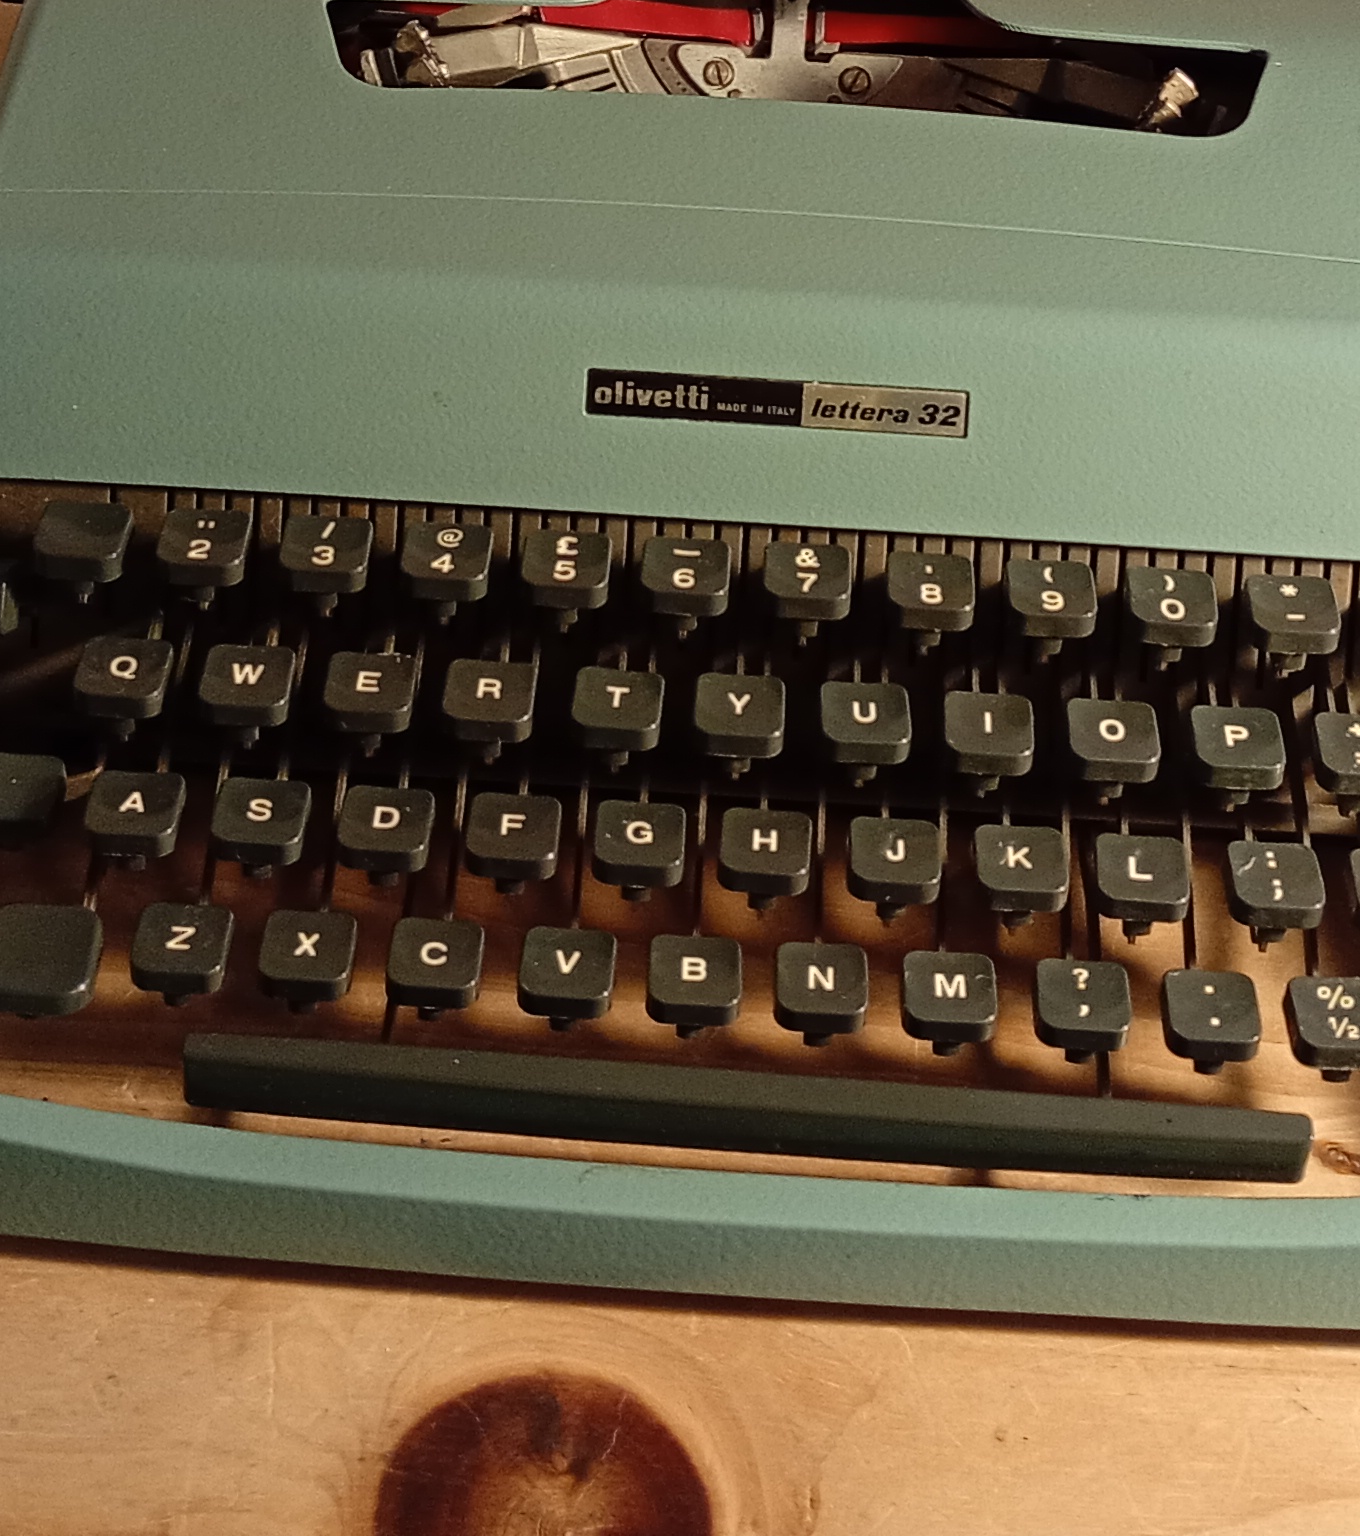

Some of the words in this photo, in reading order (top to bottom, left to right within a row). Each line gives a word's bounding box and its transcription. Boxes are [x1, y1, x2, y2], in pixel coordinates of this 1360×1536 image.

[594, 381, 709, 410] olivetti
[716, 402, 747, 413] MADE
[752, 404, 764, 414] IN
[767, 405, 796, 416] ITALY
[810, 398, 909, 424] lettera
[918, 404, 961, 428] 32
[187, 539, 211, 559] 2
[311, 545, 335, 566] 3
[430, 553, 455, 573] 4
[553, 560, 576, 581] 5
[672, 568, 695, 588] 6
[796, 572, 818, 593] 7
[920, 583, 943, 604] 8
[1041, 590, 1065, 611] 9
[436, 528, 464, 548] @
[556, 536, 579, 556] £
[795, 548, 821, 568] &
[109, 655, 138, 680] Q
[232, 663, 265, 685] W
[355, 670, 382, 692] E
[476, 677, 502, 699] R
[606, 685, 630, 708] T
[727, 692, 751, 715] Y
[852, 701, 877, 723] U
[984, 711, 992, 733] I
[1098, 718, 1125, 742] O
[1223, 724, 1249, 747] P
[119, 791, 145, 813] A
[246, 798, 273, 822] S
[372, 806, 401, 830] D
[500, 814, 526, 836] F
[626, 821, 654, 844] G
[752, 829, 778, 852] H
[885, 838, 906, 862] J
[1005, 846, 1033, 869] K
[1128, 855, 1153, 881] L
[165, 926, 196, 950] Z
[294, 932, 320, 957] X
[420, 941, 448, 966] C
[555, 949, 581, 974] V
[681, 956, 707, 981] B
[807, 965, 834, 991] N
[934, 973, 967, 999] M
[1072, 967, 1089, 990] ?
